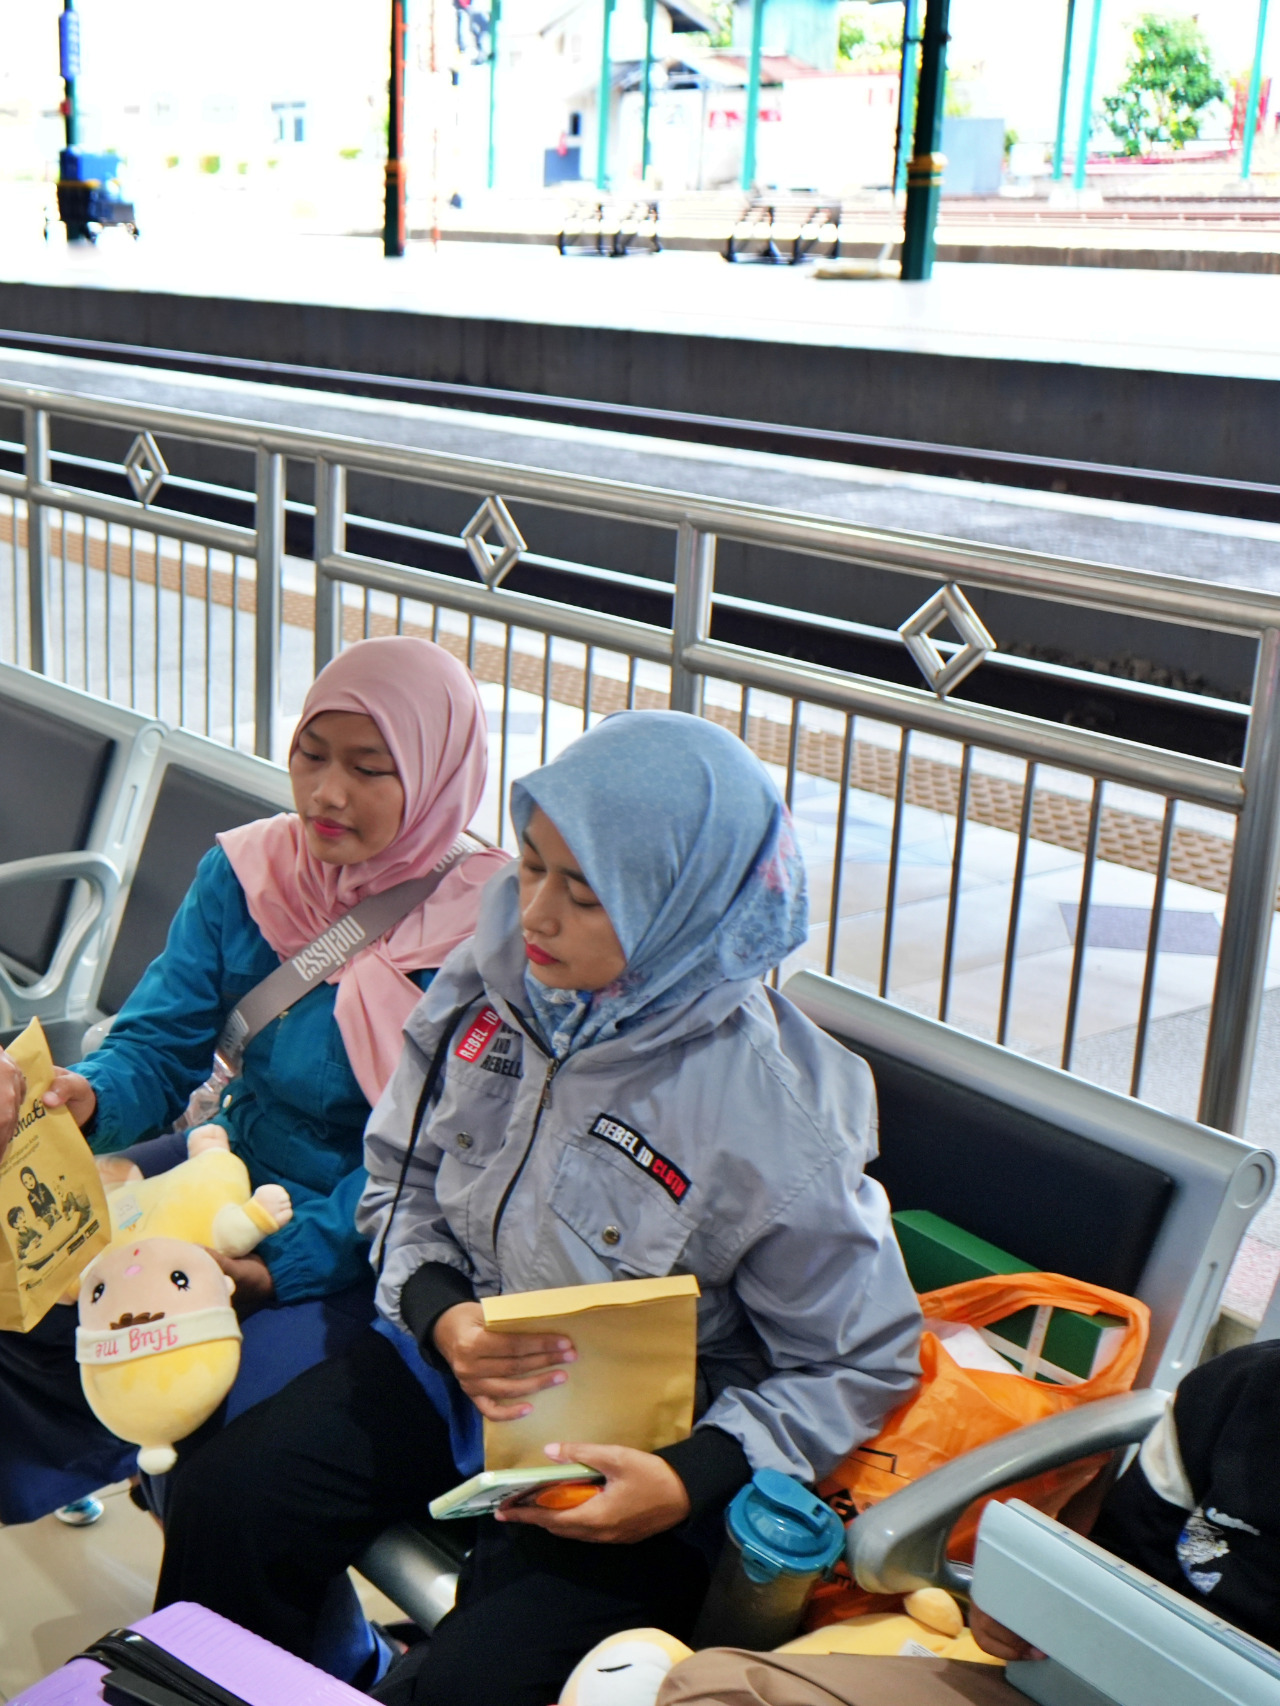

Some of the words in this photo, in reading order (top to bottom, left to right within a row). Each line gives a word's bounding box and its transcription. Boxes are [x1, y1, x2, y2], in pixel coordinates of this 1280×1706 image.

[291, 914, 366, 981] melissa
[458, 1027, 489, 1060] REBEL
[482, 1010, 500, 1026] ID
[480, 1054, 524, 1080] REBELL
[593, 1117, 639, 1154] REBEL
[635, 1145, 655, 1168] ID
[652, 1158, 687, 1198] CLOTH
[95, 1340, 119, 1359] me
[128, 1323, 180, 1353] Hug
